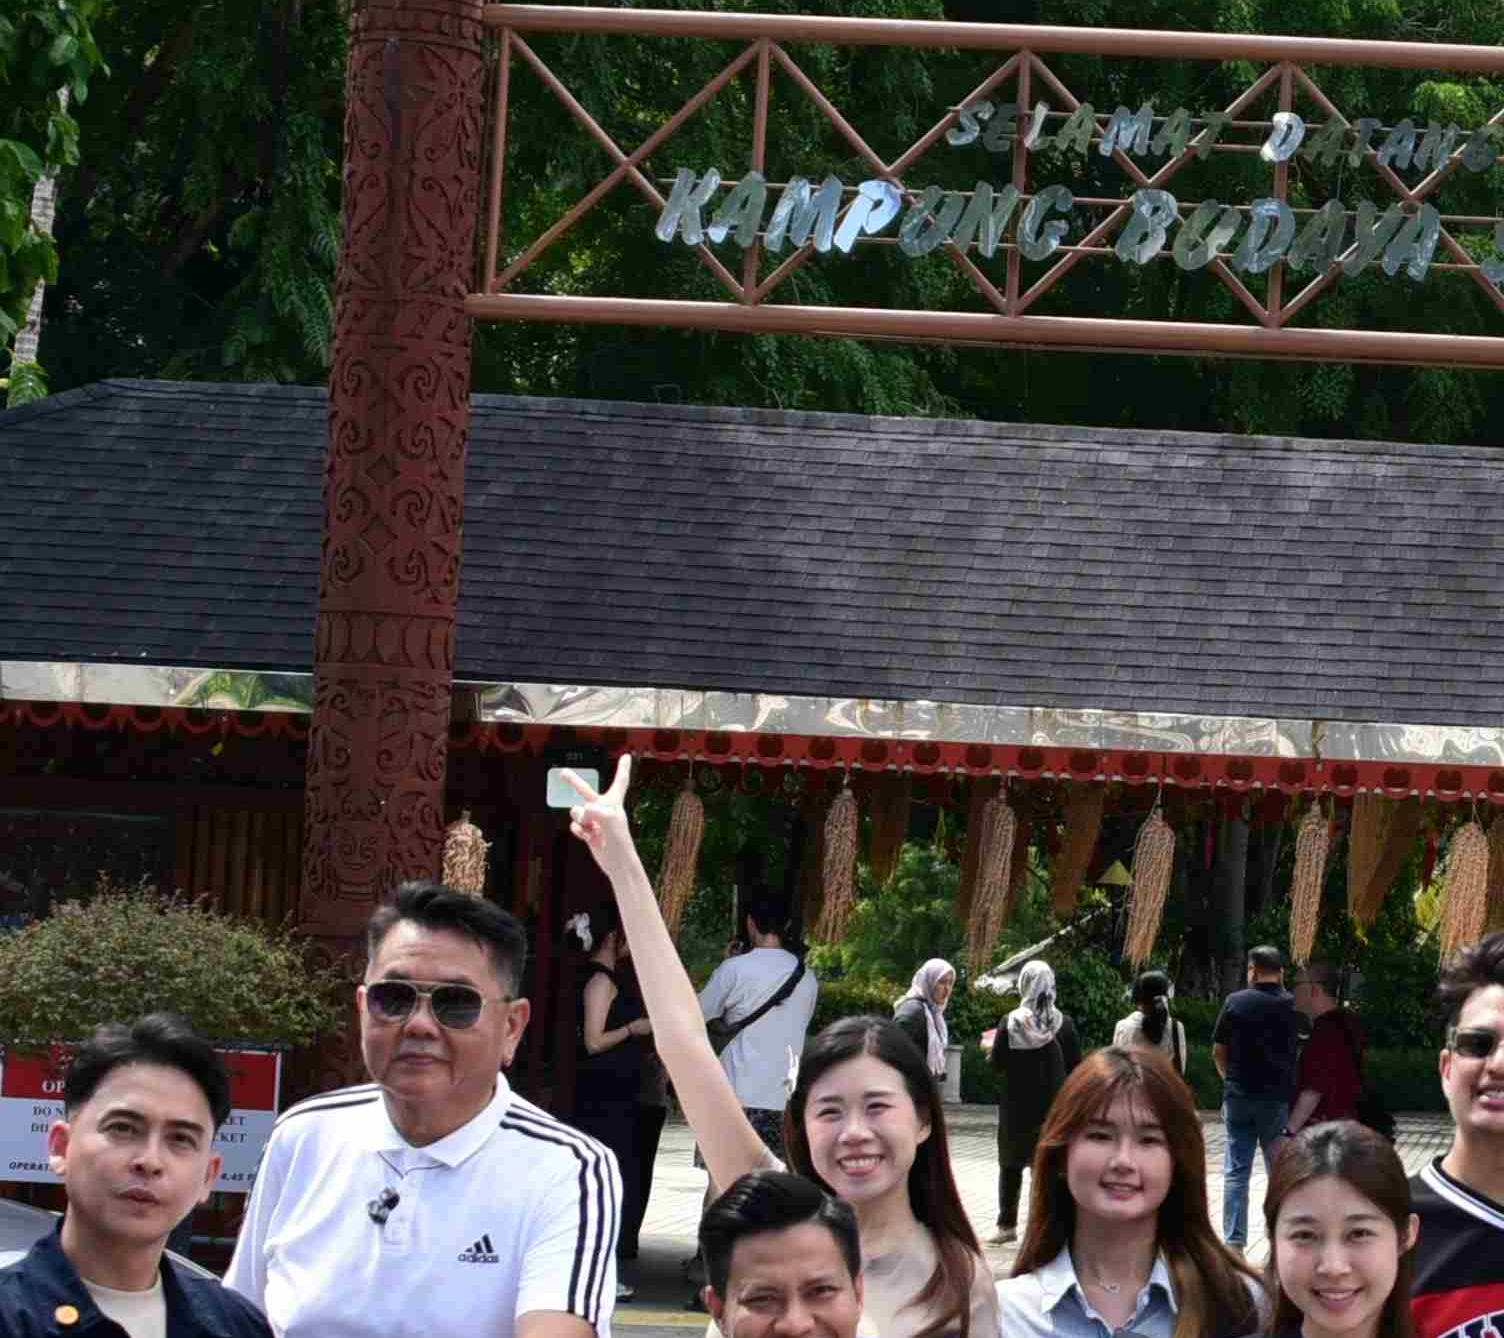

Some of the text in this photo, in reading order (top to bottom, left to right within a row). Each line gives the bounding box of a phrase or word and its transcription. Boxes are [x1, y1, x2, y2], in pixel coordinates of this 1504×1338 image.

[946, 100, 1232, 160] SELAMAT
[1260, 112, 1503, 173] DATANG
[655, 167, 1073, 262] KAMPUNG
[1115, 189, 1441, 282] BUDAYA
